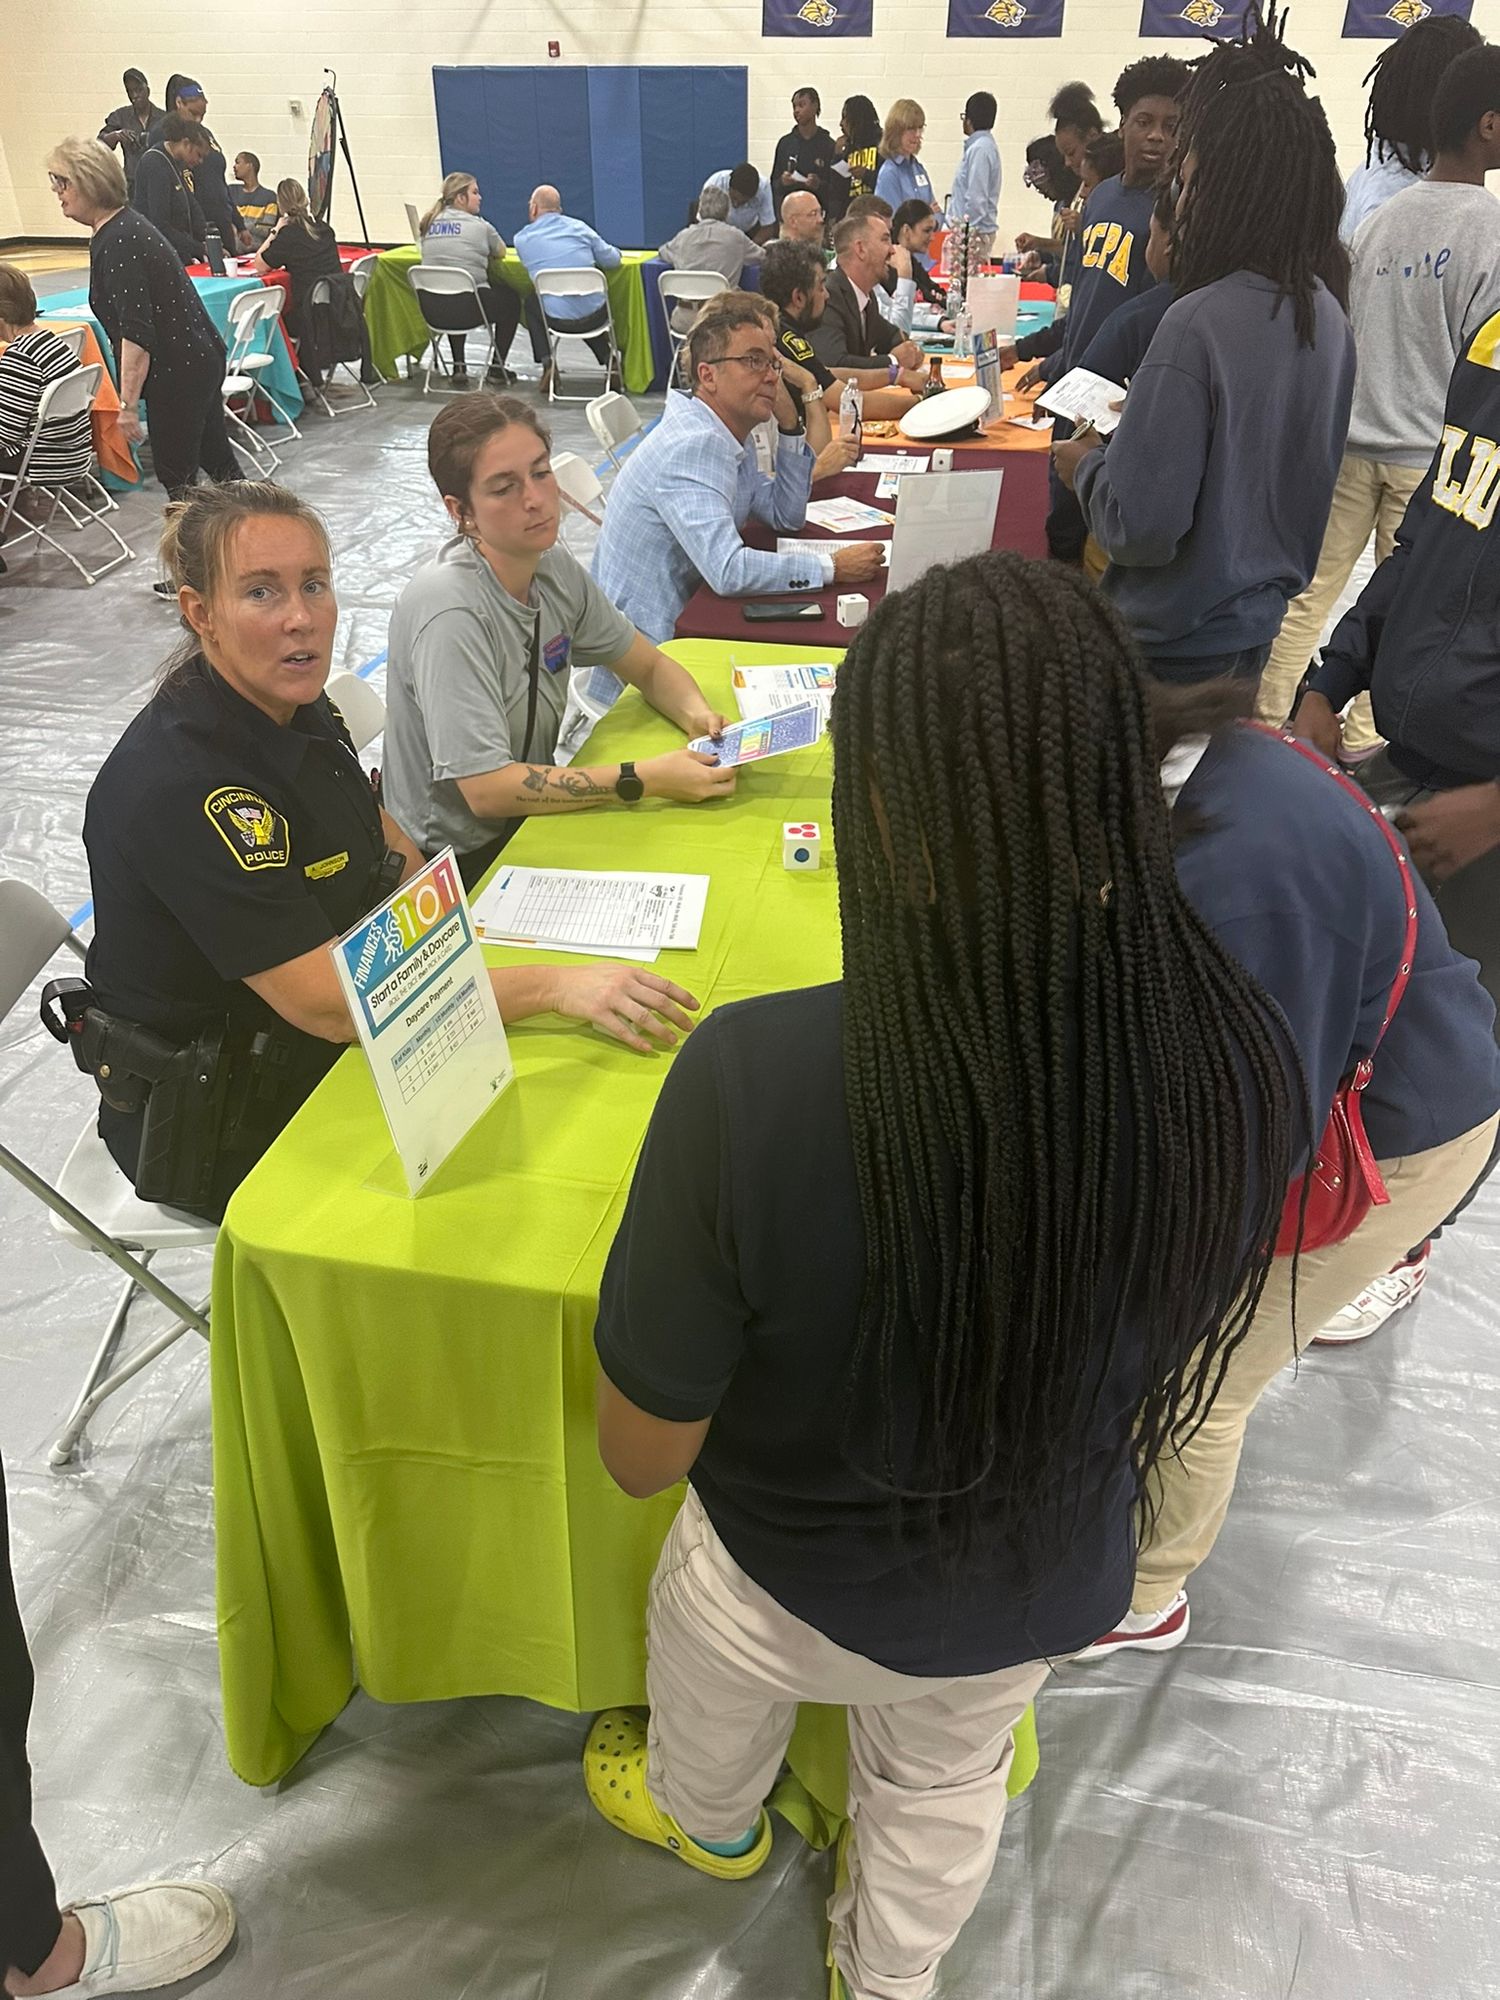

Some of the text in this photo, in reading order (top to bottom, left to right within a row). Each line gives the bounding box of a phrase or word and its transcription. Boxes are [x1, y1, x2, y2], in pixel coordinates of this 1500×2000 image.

[428, 222, 462, 235] DOWNS
[245, 850, 285, 864] POLICE
[353, 921, 383, 990] FINANCES
[370, 921, 459, 1008] Start a Family & Daycare
[405, 1000, 430, 1028] Daycare
[429, 976, 453, 1005] Payment
